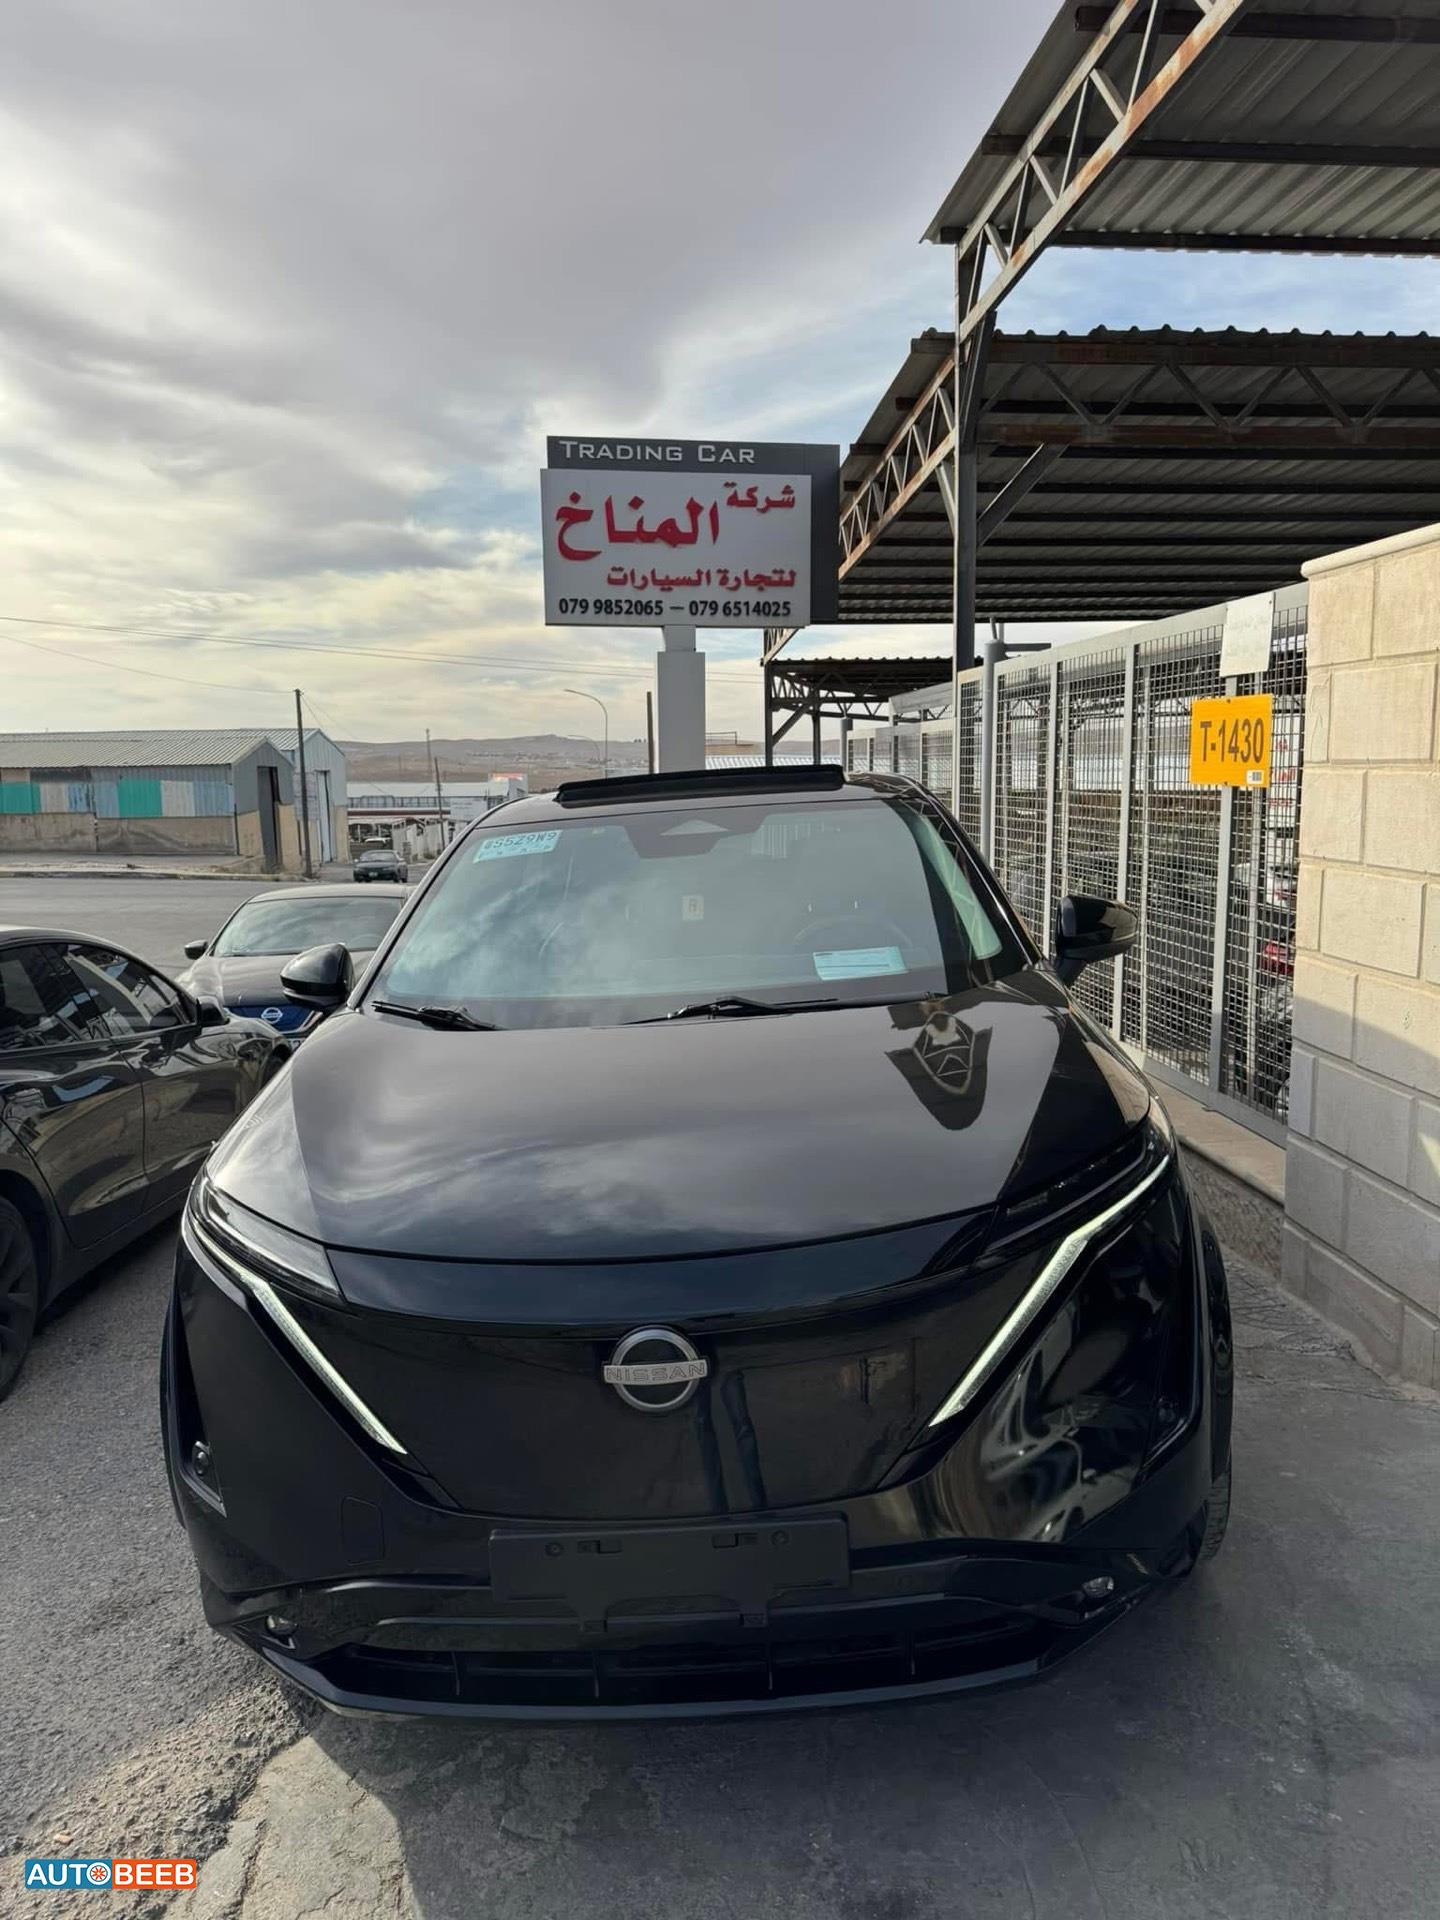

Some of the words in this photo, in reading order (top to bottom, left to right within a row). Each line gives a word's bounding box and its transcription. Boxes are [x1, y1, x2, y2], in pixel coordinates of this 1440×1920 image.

[559, 440, 683, 462] TRADING
[697, 444, 755, 464] CAR
[724, 481, 796, 514] شركة
[555, 491, 721, 562] المناخ
[606, 566, 712, 592] السيارات
[717, 567, 797, 592] لتجارة
[558, 598, 589, 615] 079
[593, 598, 664, 616] 9852065
[689, 600, 719, 616] 079
[722, 600, 791, 617] 6514025
[1200, 717, 1265, 764] T-1430
[606, 1363, 706, 1382] NISSAN
